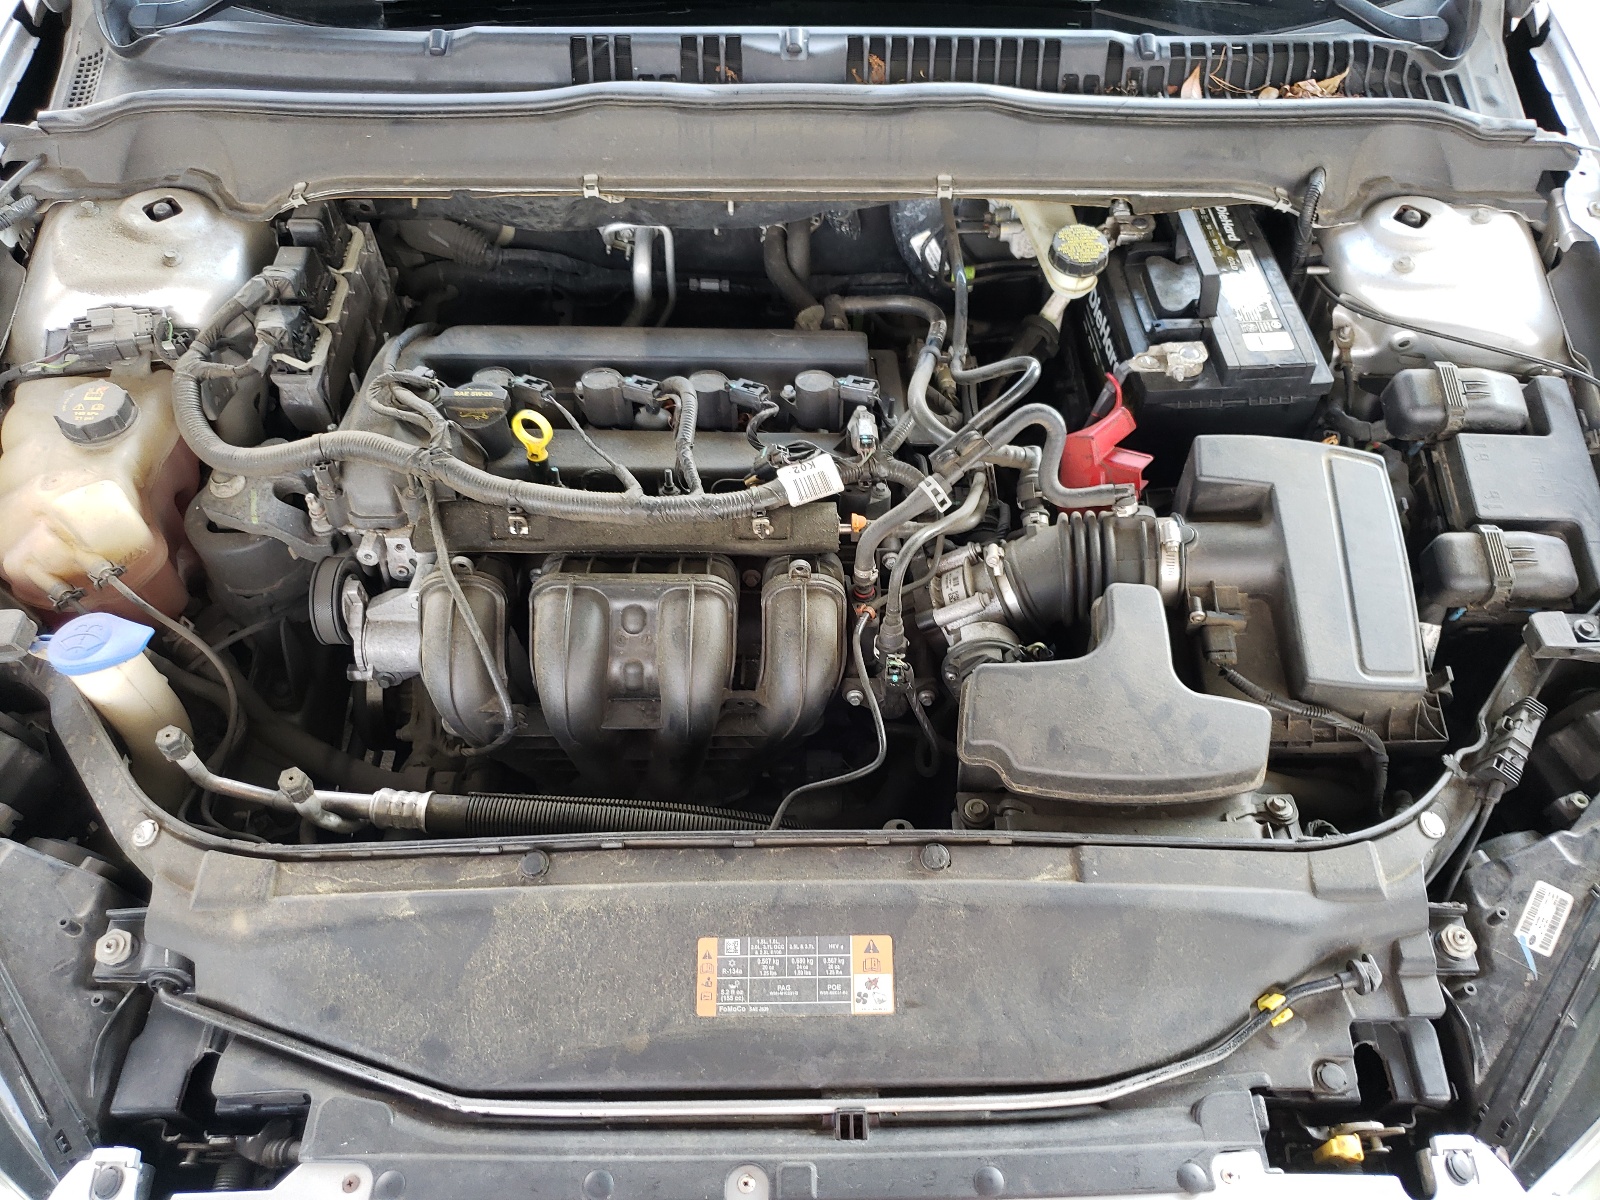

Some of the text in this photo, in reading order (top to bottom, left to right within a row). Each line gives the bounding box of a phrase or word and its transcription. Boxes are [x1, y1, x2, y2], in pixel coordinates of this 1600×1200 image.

[1216, 206, 1241, 242] DieHard
[1227, 256, 1239, 271] GOLD
[722, 967, 743, 975] R-134a
